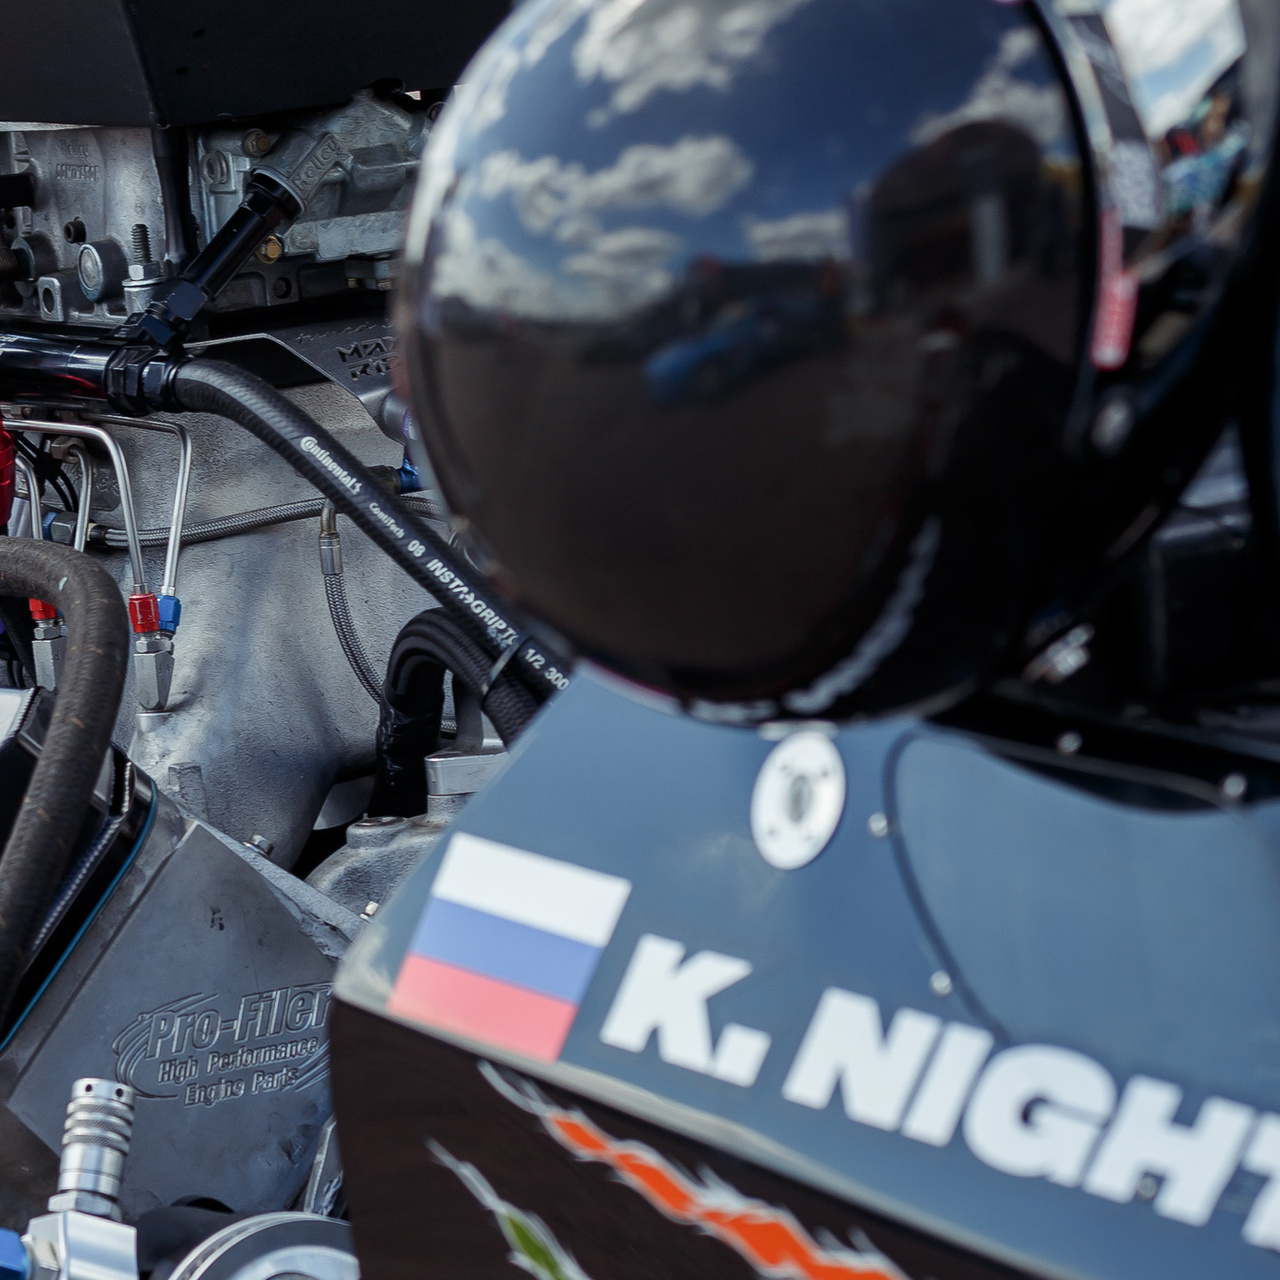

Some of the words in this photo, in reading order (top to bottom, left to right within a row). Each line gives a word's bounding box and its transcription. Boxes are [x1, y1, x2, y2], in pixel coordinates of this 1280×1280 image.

[407, 539, 426, 557] 08
[525, 648, 546, 669] 1/2
[544, 667, 569, 691] 300
[157, 1056, 198, 1084] High
[207, 1036, 320, 1074] Performance
[599, 932, 773, 1088] K.
[183, 1080, 245, 1108] Engine
[251, 1066, 300, 1095] Parts
